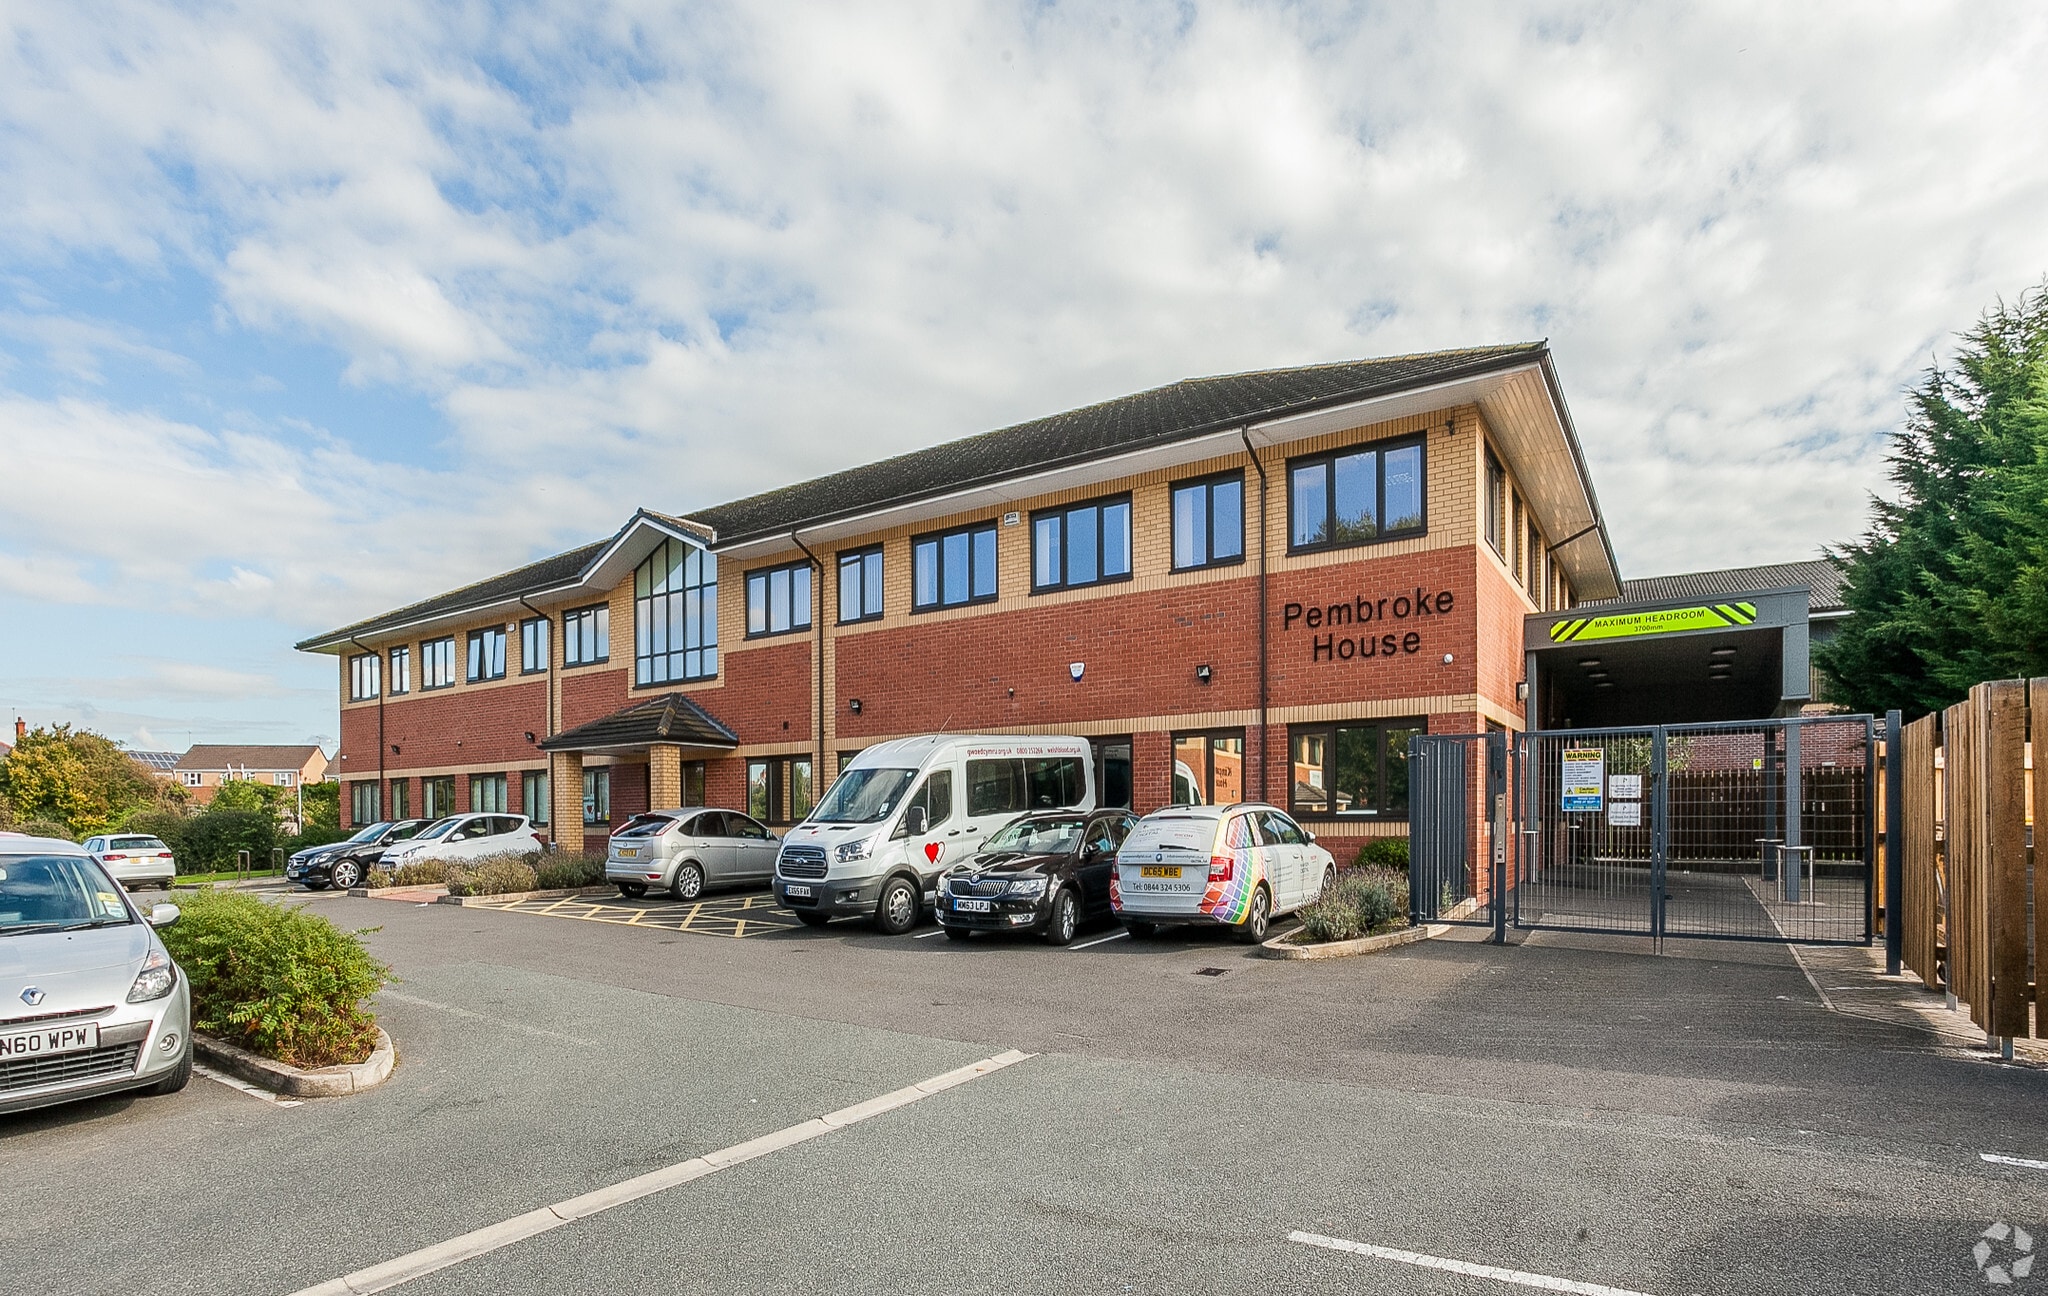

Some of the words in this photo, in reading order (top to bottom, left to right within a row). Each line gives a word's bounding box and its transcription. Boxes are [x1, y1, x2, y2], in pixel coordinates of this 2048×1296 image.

[1284, 587, 1454, 631] Pembroke
[1594, 616, 1642, 629] MAXIMUM
[1645, 609, 1706, 624] HEADROOM
[1633, 623, 1664, 633] 3700mm
[1313, 631, 1421, 663] House
[1565, 751, 1601, 759] WARNING
[1143, 866, 1162, 876] DC65
[1163, 867, 1179, 876] WBE
[1133, 882, 1143, 891] Tel:
[1143, 883, 1160, 891] 0844
[1161, 883, 1175, 891] 324
[1174, 883, 1191, 892] 5306
[975, 901, 989, 911] LPJ
[48, 1028, 87, 1049] WPW
